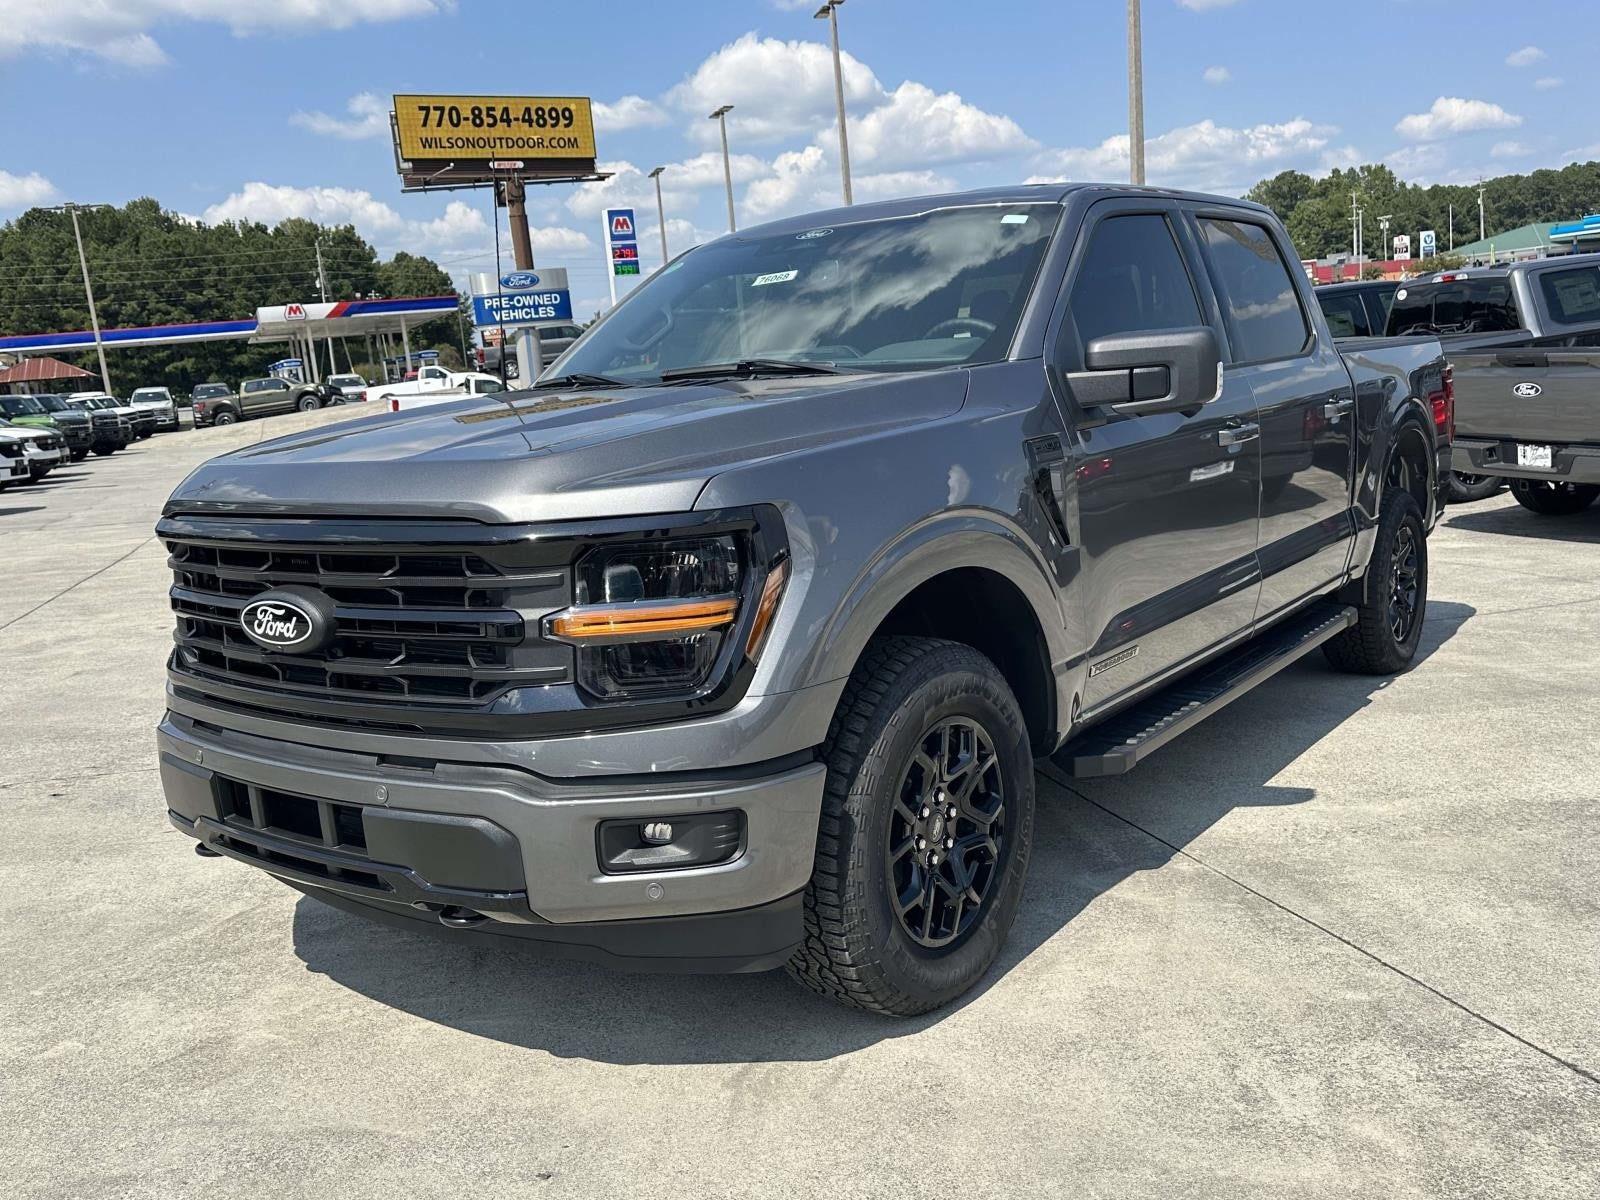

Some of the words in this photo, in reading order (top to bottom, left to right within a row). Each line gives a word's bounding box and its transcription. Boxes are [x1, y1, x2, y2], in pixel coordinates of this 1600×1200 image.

[418, 106, 574, 128] 770-854-4899
[420, 137, 579, 149] WILSONOUTDOOR.COM
[508, 275, 531, 287] Ford
[484, 293, 561, 310] PRE-OWNED
[493, 306, 556, 321] VEHICLES
[253, 606, 297, 638] Ford
